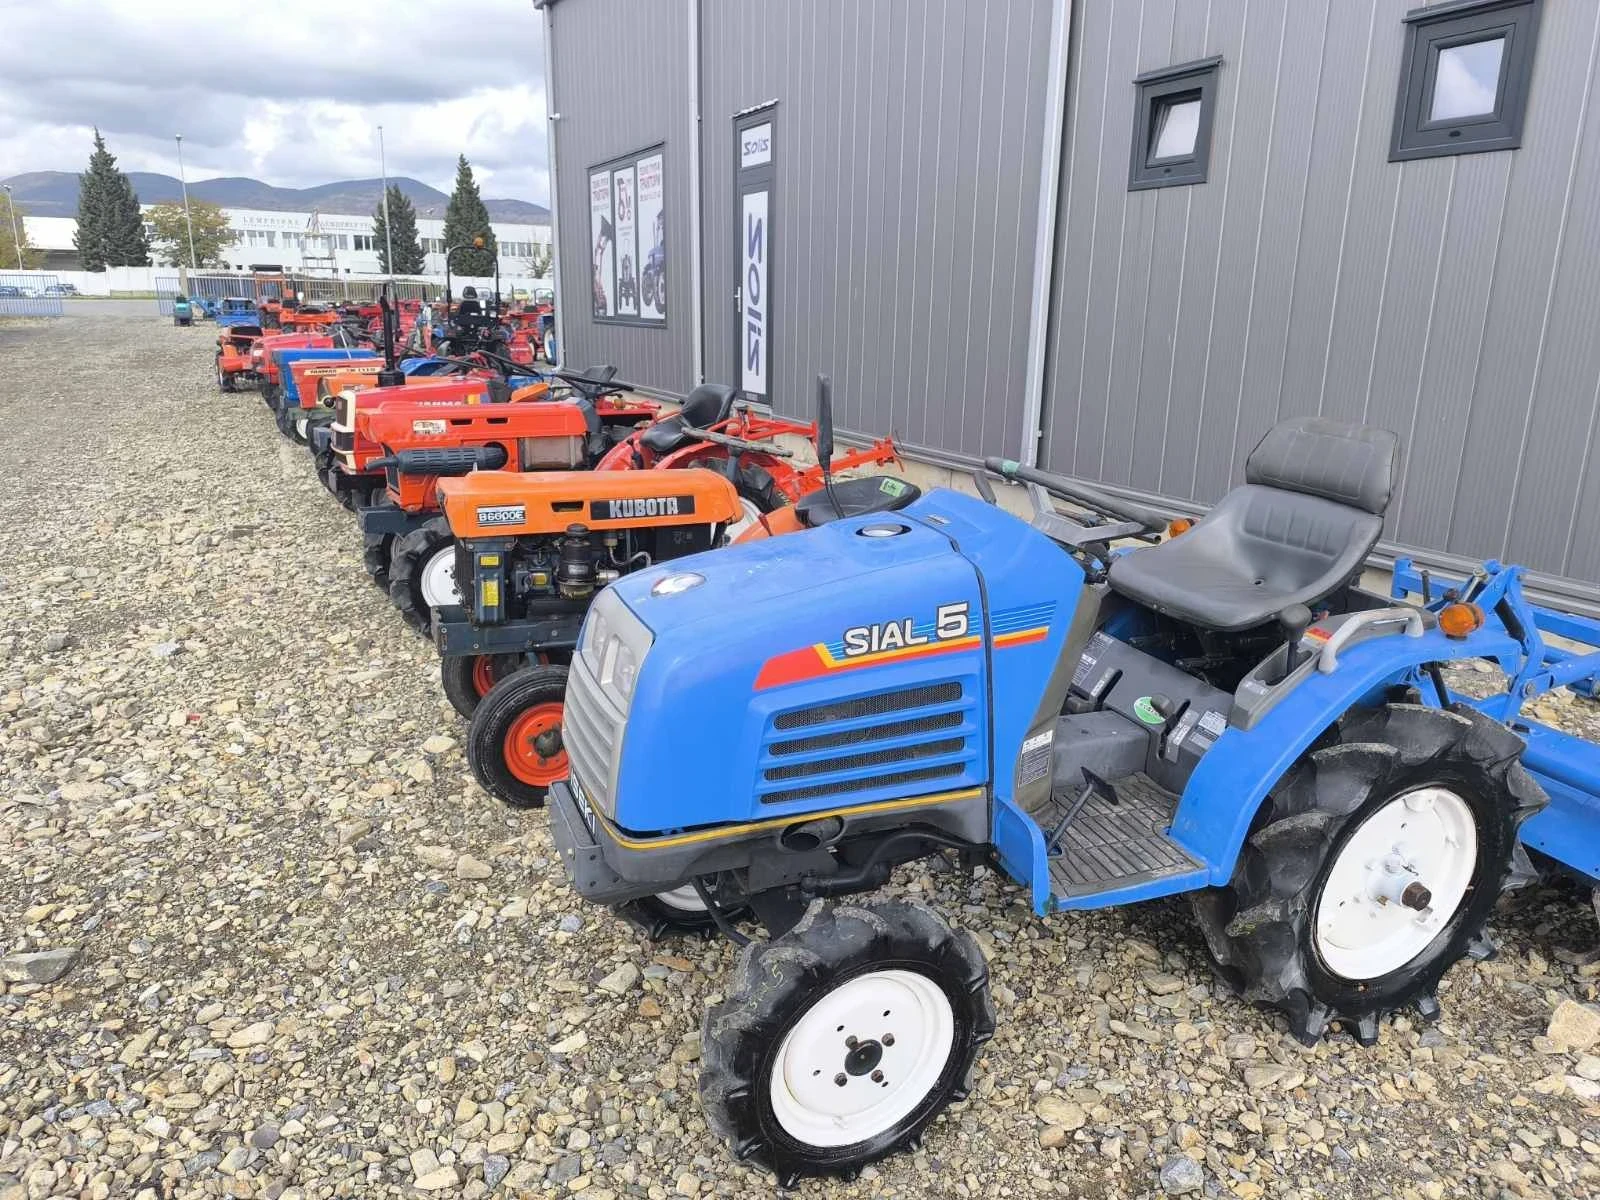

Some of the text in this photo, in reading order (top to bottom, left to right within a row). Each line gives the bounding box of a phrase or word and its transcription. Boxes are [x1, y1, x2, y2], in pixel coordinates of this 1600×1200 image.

[608, 497, 679, 518] KUBOTA
[843, 601, 970, 657] SIAL 5
